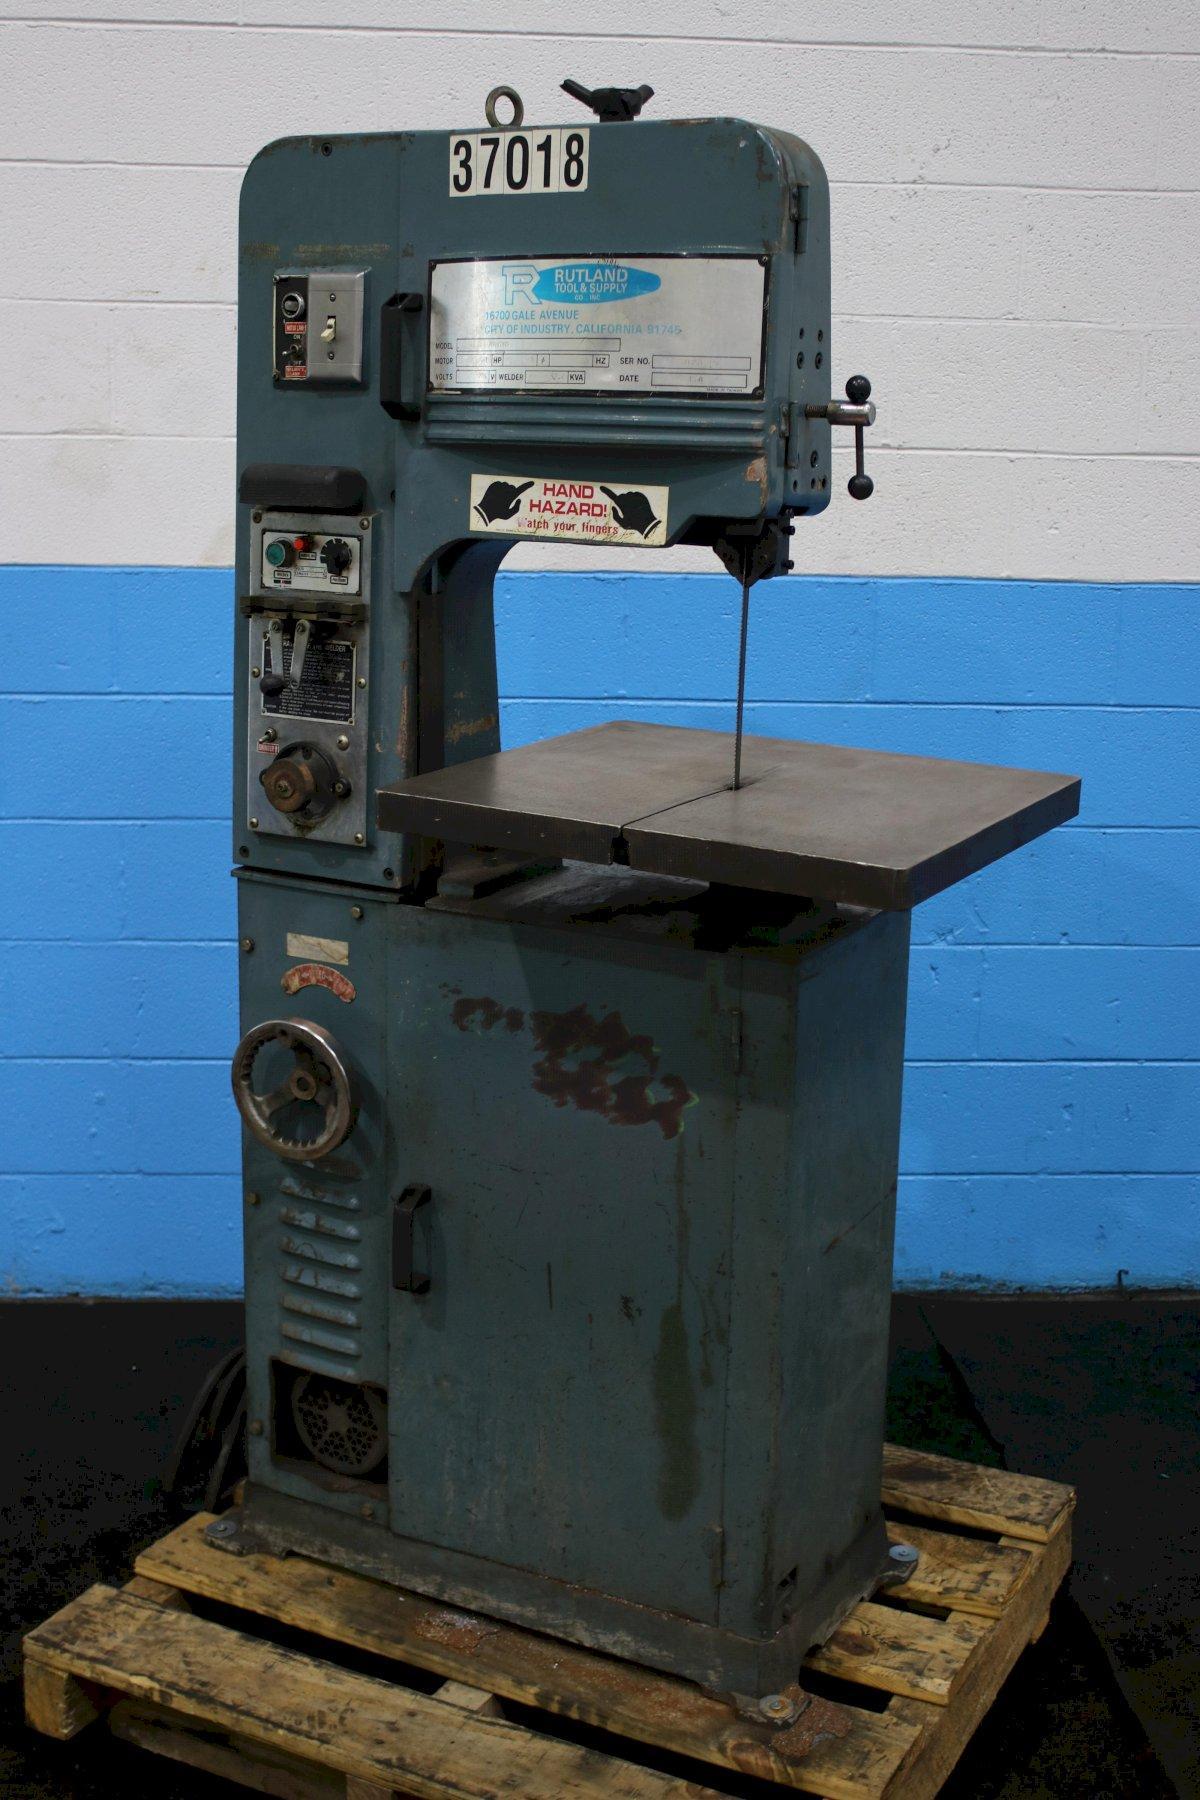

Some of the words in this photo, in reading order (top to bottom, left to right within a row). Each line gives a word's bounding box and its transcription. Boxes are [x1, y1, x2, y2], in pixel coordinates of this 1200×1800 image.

[453, 133, 584, 192] 37018
[554, 269, 628, 283] RUTLAND
[554, 283, 578, 293] TOOL
[580, 283, 588, 293] &
[589, 283, 628, 294] SUPPLY
[512, 311, 536, 320] GALE
[539, 310, 579, 320] AVENUE
[484, 325, 505, 334] CITY
[506, 325, 518, 334] OF
[576, 324, 642, 334] CALIFORNIA
[435, 342, 453, 350] MODEL
[435, 357, 453, 365] MOTOR
[493, 356, 502, 364] HP
[595, 357, 606, 365] HZ
[620, 357, 634, 365] SER
[435, 373, 453, 381] VOLTS
[499, 372, 524, 381] WELDER
[569, 373, 583, 381] KVA
[543, 483, 594, 499] HAND
[529, 499, 607, 518] HAZARD!
[554, 521, 575, 532] your
[582, 521, 618, 535] fingers
